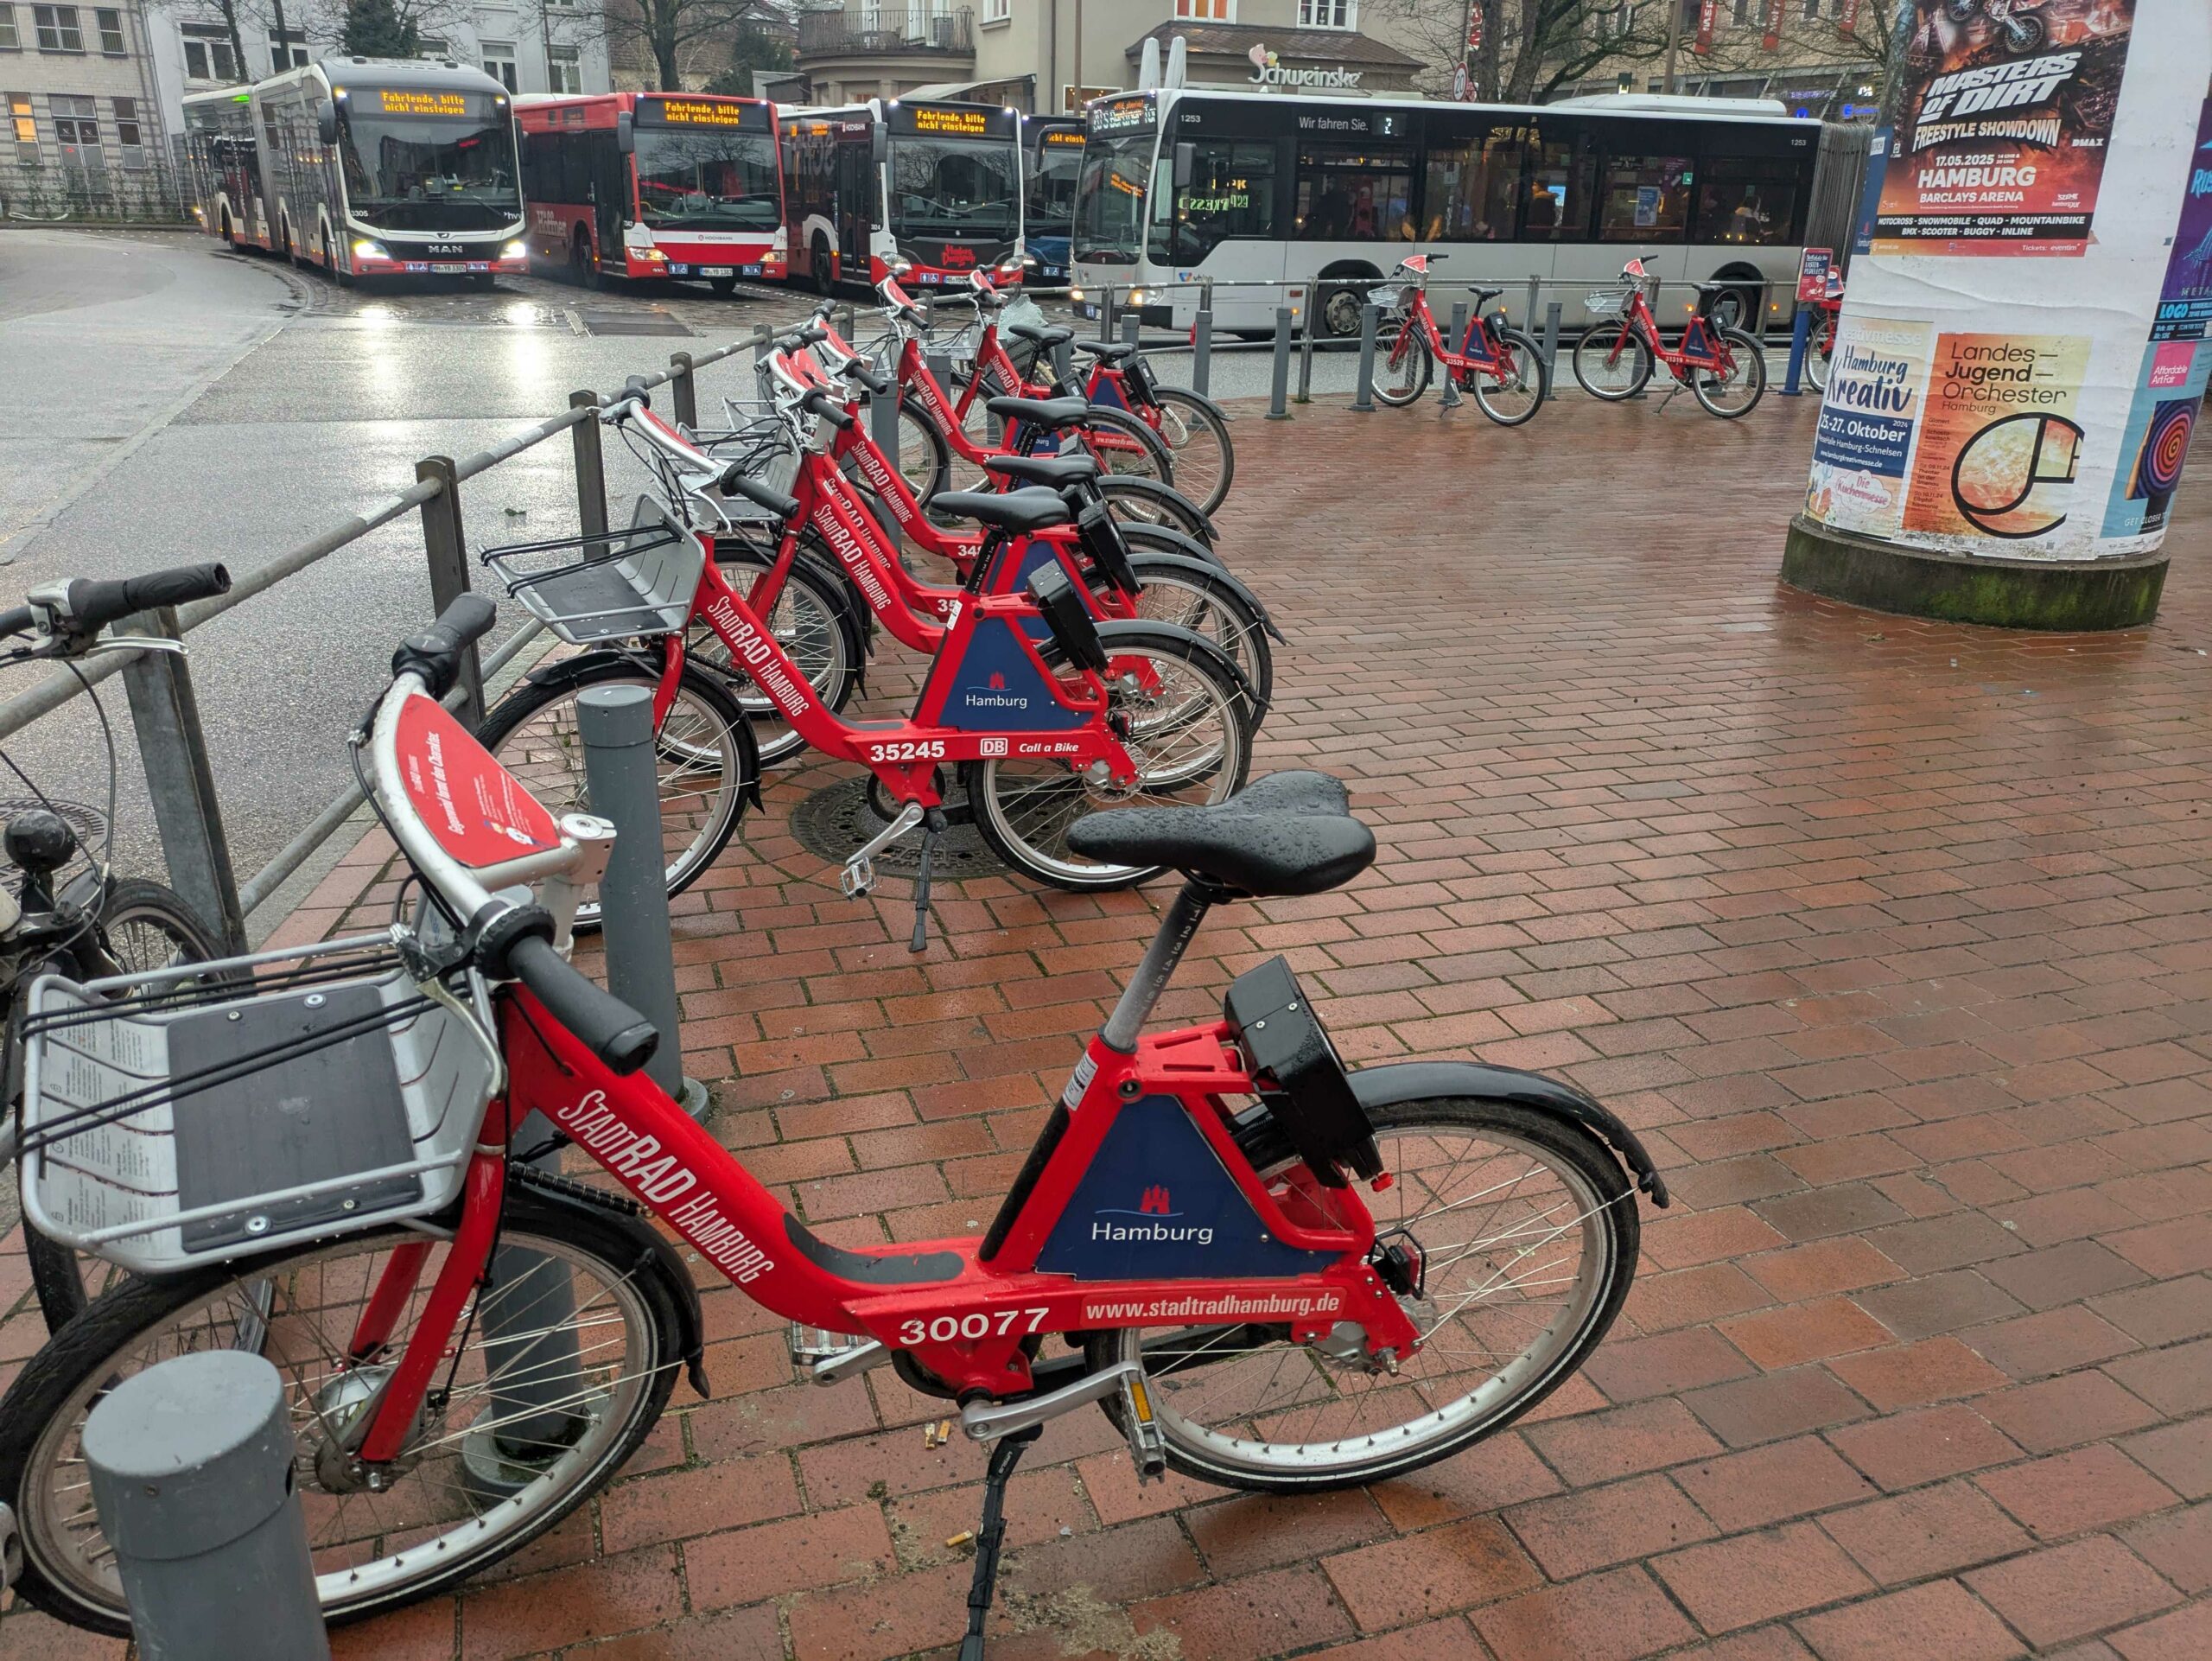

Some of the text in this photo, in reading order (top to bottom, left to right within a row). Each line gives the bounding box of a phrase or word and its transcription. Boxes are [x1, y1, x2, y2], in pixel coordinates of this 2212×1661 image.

[1248, 43, 1360, 87] Schweinske
[1455, 74, 1465, 93] 20
[1930, 52, 2082, 98] MASTERS
[441, 95, 465, 105] bitte
[1923, 73, 2072, 117] OF DIRT
[385, 103, 465, 114] nicht einsteigen
[666, 112, 740, 124] nicht einsteigen
[717, 105, 740, 116] bitte
[918, 120, 985, 133] nicht einsteigen
[965, 113, 986, 124] bitte
[1299, 117, 1369, 131] Wir fahren Sie.
[1912, 123, 1976, 152] FREESTYLE
[1978, 118, 2062, 148] SHOWDOWN
[2071, 138, 2103, 147] DMAX
[1936, 154, 1995, 167] 17.05.2025
[1917, 166, 2037, 188] HAMBURG
[1919, 191, 2024, 203] BARCLAYS ARENA
[1917, 217, 1971, 226] SNOWMOBILE
[2012, 216, 2086, 225] MOUNTAINBIKE
[1922, 227, 1959, 236] SCOOTER
[2159, 303, 2189, 319] LOGO
[1844, 345, 1909, 384] Hamburg
[2154, 365, 2188, 375] Affordable
[1827, 356, 1913, 412] Kreativ
[2151, 375, 2163, 384] Art
[1942, 381, 2067, 404] Orchester
[1942, 401, 1997, 415] Hamburg
[931, 401, 953, 436] HAMBURG
[1847, 420, 1906, 442] Oktober
[1836, 438, 1903, 457] Hamburg-Schnelsen
[1857, 475, 1871, 489] Die
[881, 483, 913, 523] HAMBURG
[851, 559, 892, 610] HAMBURG
[760, 657, 810, 719] HAMBURG
[965, 693, 1028, 710] Hamburg
[870, 740, 945, 762] 35245
[983, 741, 1006, 753] DB
[1019, 743, 1041, 753] Call
[1053, 742, 1079, 753] Bike
[668, 1191, 775, 1284] HAMBURG
[1091, 1221, 1213, 1244] Hamburg
[899, 1293, 1339, 1346] 30077 www.stadtradhamburg.de
